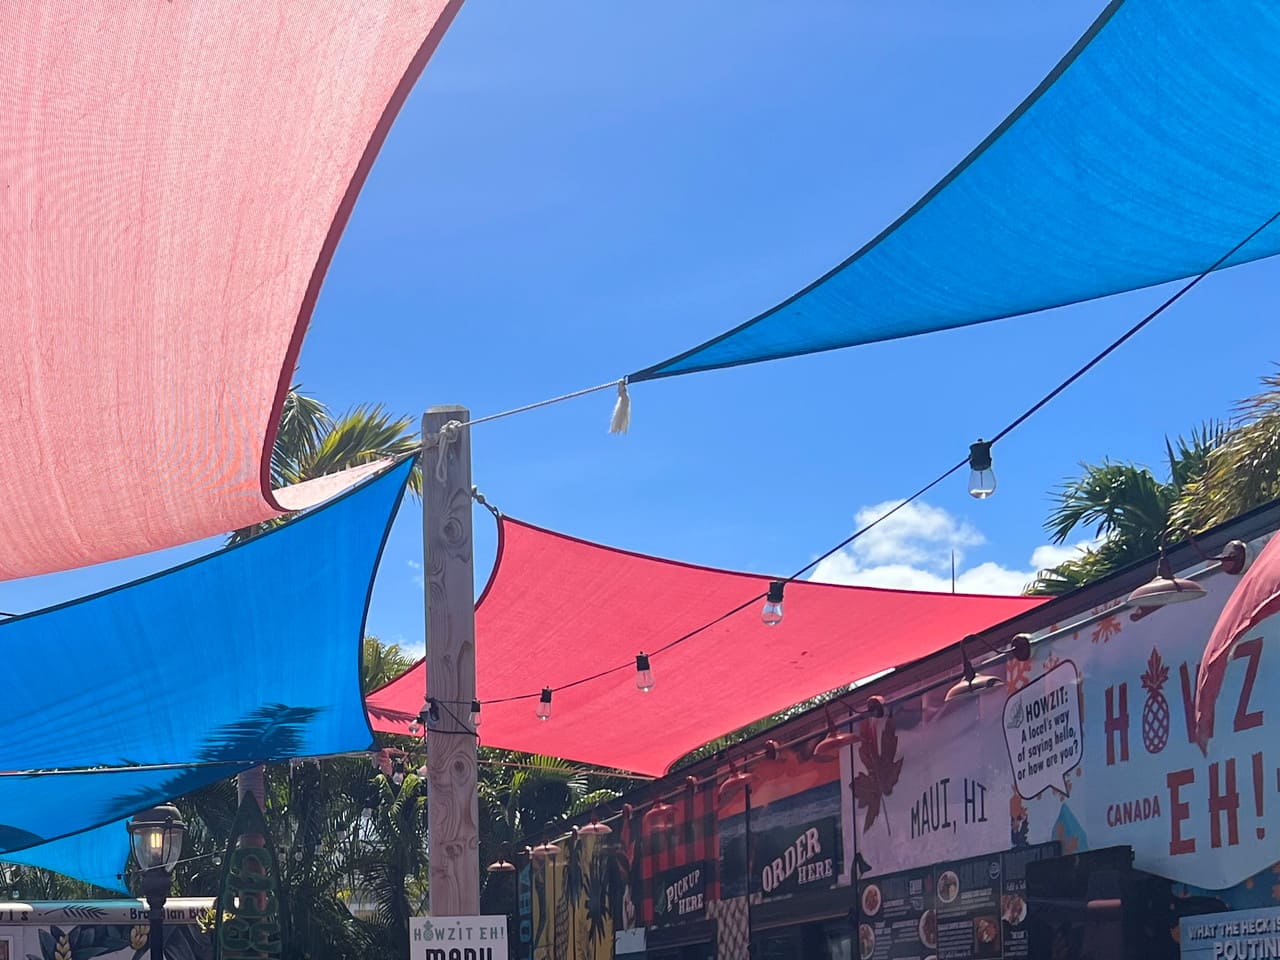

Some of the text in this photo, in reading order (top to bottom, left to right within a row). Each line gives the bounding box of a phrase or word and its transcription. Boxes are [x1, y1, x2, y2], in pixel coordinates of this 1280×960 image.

[1026, 687, 1068, 722] HOWZIT:
[1017, 726, 1076, 762] of saying hello,
[1021, 710, 1070, 744] A local's way
[1017, 739, 1078, 781] or how are you?
[911, 777, 988, 840] MAUI, HI
[1107, 795, 1161, 828] CANADA
[1167, 751, 1266, 856] EH!
[762, 827, 821, 893] ORDER
[797, 858, 833, 885] HERE
[678, 893, 704, 915] HERE
[479, 926, 505, 940] EH!
[1188, 924, 1217, 940] WHAT
[1218, 922, 1240, 937] THE
[1241, 918, 1271, 935] HECK
